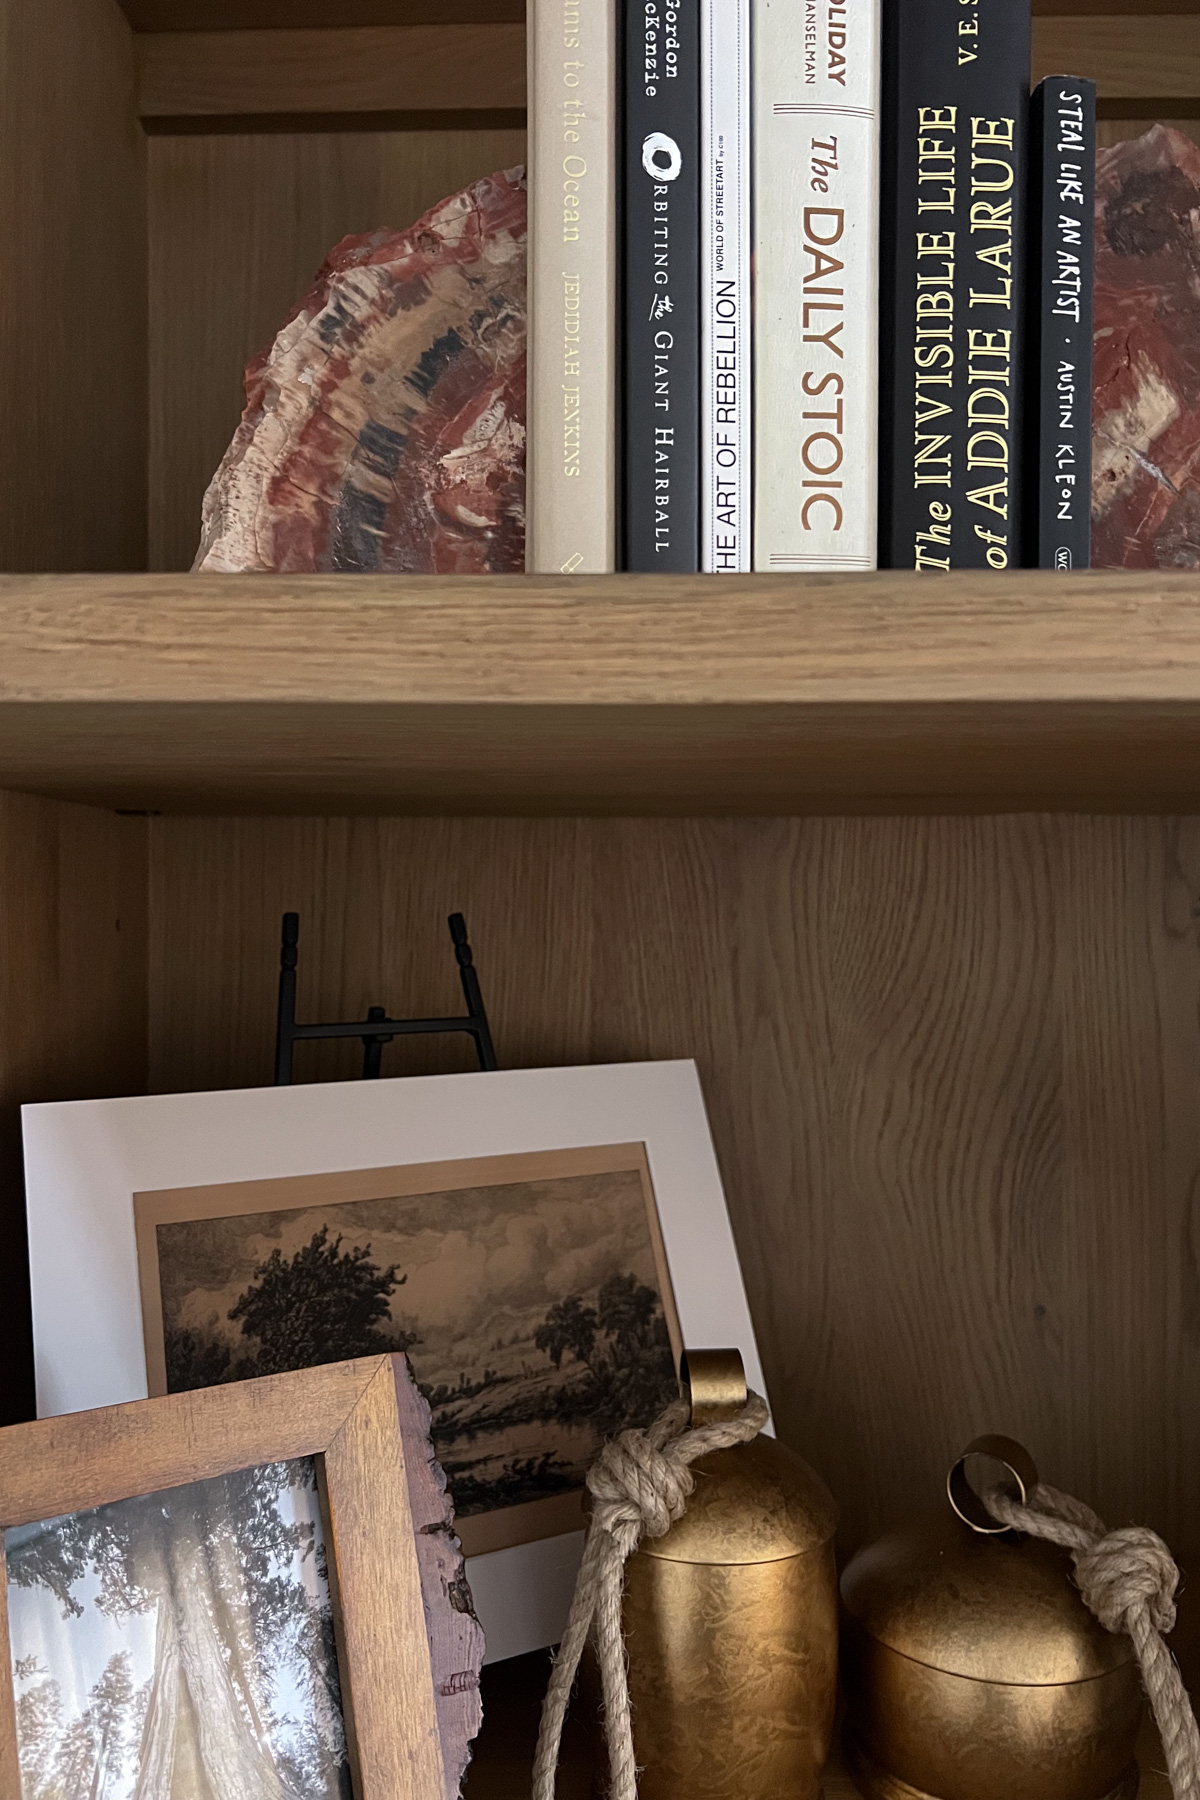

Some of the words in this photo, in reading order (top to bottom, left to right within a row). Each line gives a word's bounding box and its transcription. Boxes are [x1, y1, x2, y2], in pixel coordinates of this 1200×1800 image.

[644, 0, 660, 97] cKenzie
[958, 12, 979, 36] E.
[958, 43, 978, 66] V.
[562, 61, 584, 89] to
[562, 99, 587, 143] the
[1057, 90, 1086, 152] STEAL
[715, 159, 724, 217] STREETART
[810, 135, 839, 193] The
[917, 105, 958, 215] LIFE
[1056, 163, 1084, 205] LIKE
[561, 154, 586, 243] Ocean
[715, 219, 724, 233] OF
[968, 116, 1015, 310] LARUE
[1057, 214, 1082, 245] AN
[715, 235, 724, 272] WORLD
[802, 206, 845, 359] DAILY
[1051, 250, 1082, 323] ARTIST
[562, 271, 580, 377] JEDIDIAH
[648, 293, 674, 321] the
[654, 330, 674, 412] GIANT
[715, 280, 736, 424] REBELLION
[913, 231, 956, 489] INVISIBLE
[965, 328, 1012, 521] ADDIE
[1056, 360, 1076, 429] AUSTIN
[561, 385, 580, 477] JENKINS
[716, 432, 737, 468] OF
[800, 371, 844, 531] STOIC
[655, 427, 674, 553] HAIRBALL
[716, 475, 736, 527] ART
[1054, 444, 1076, 520] KLEON
[716, 534, 736, 574] HE
[914, 501, 952, 572] The
[974, 524, 1008, 569] of
